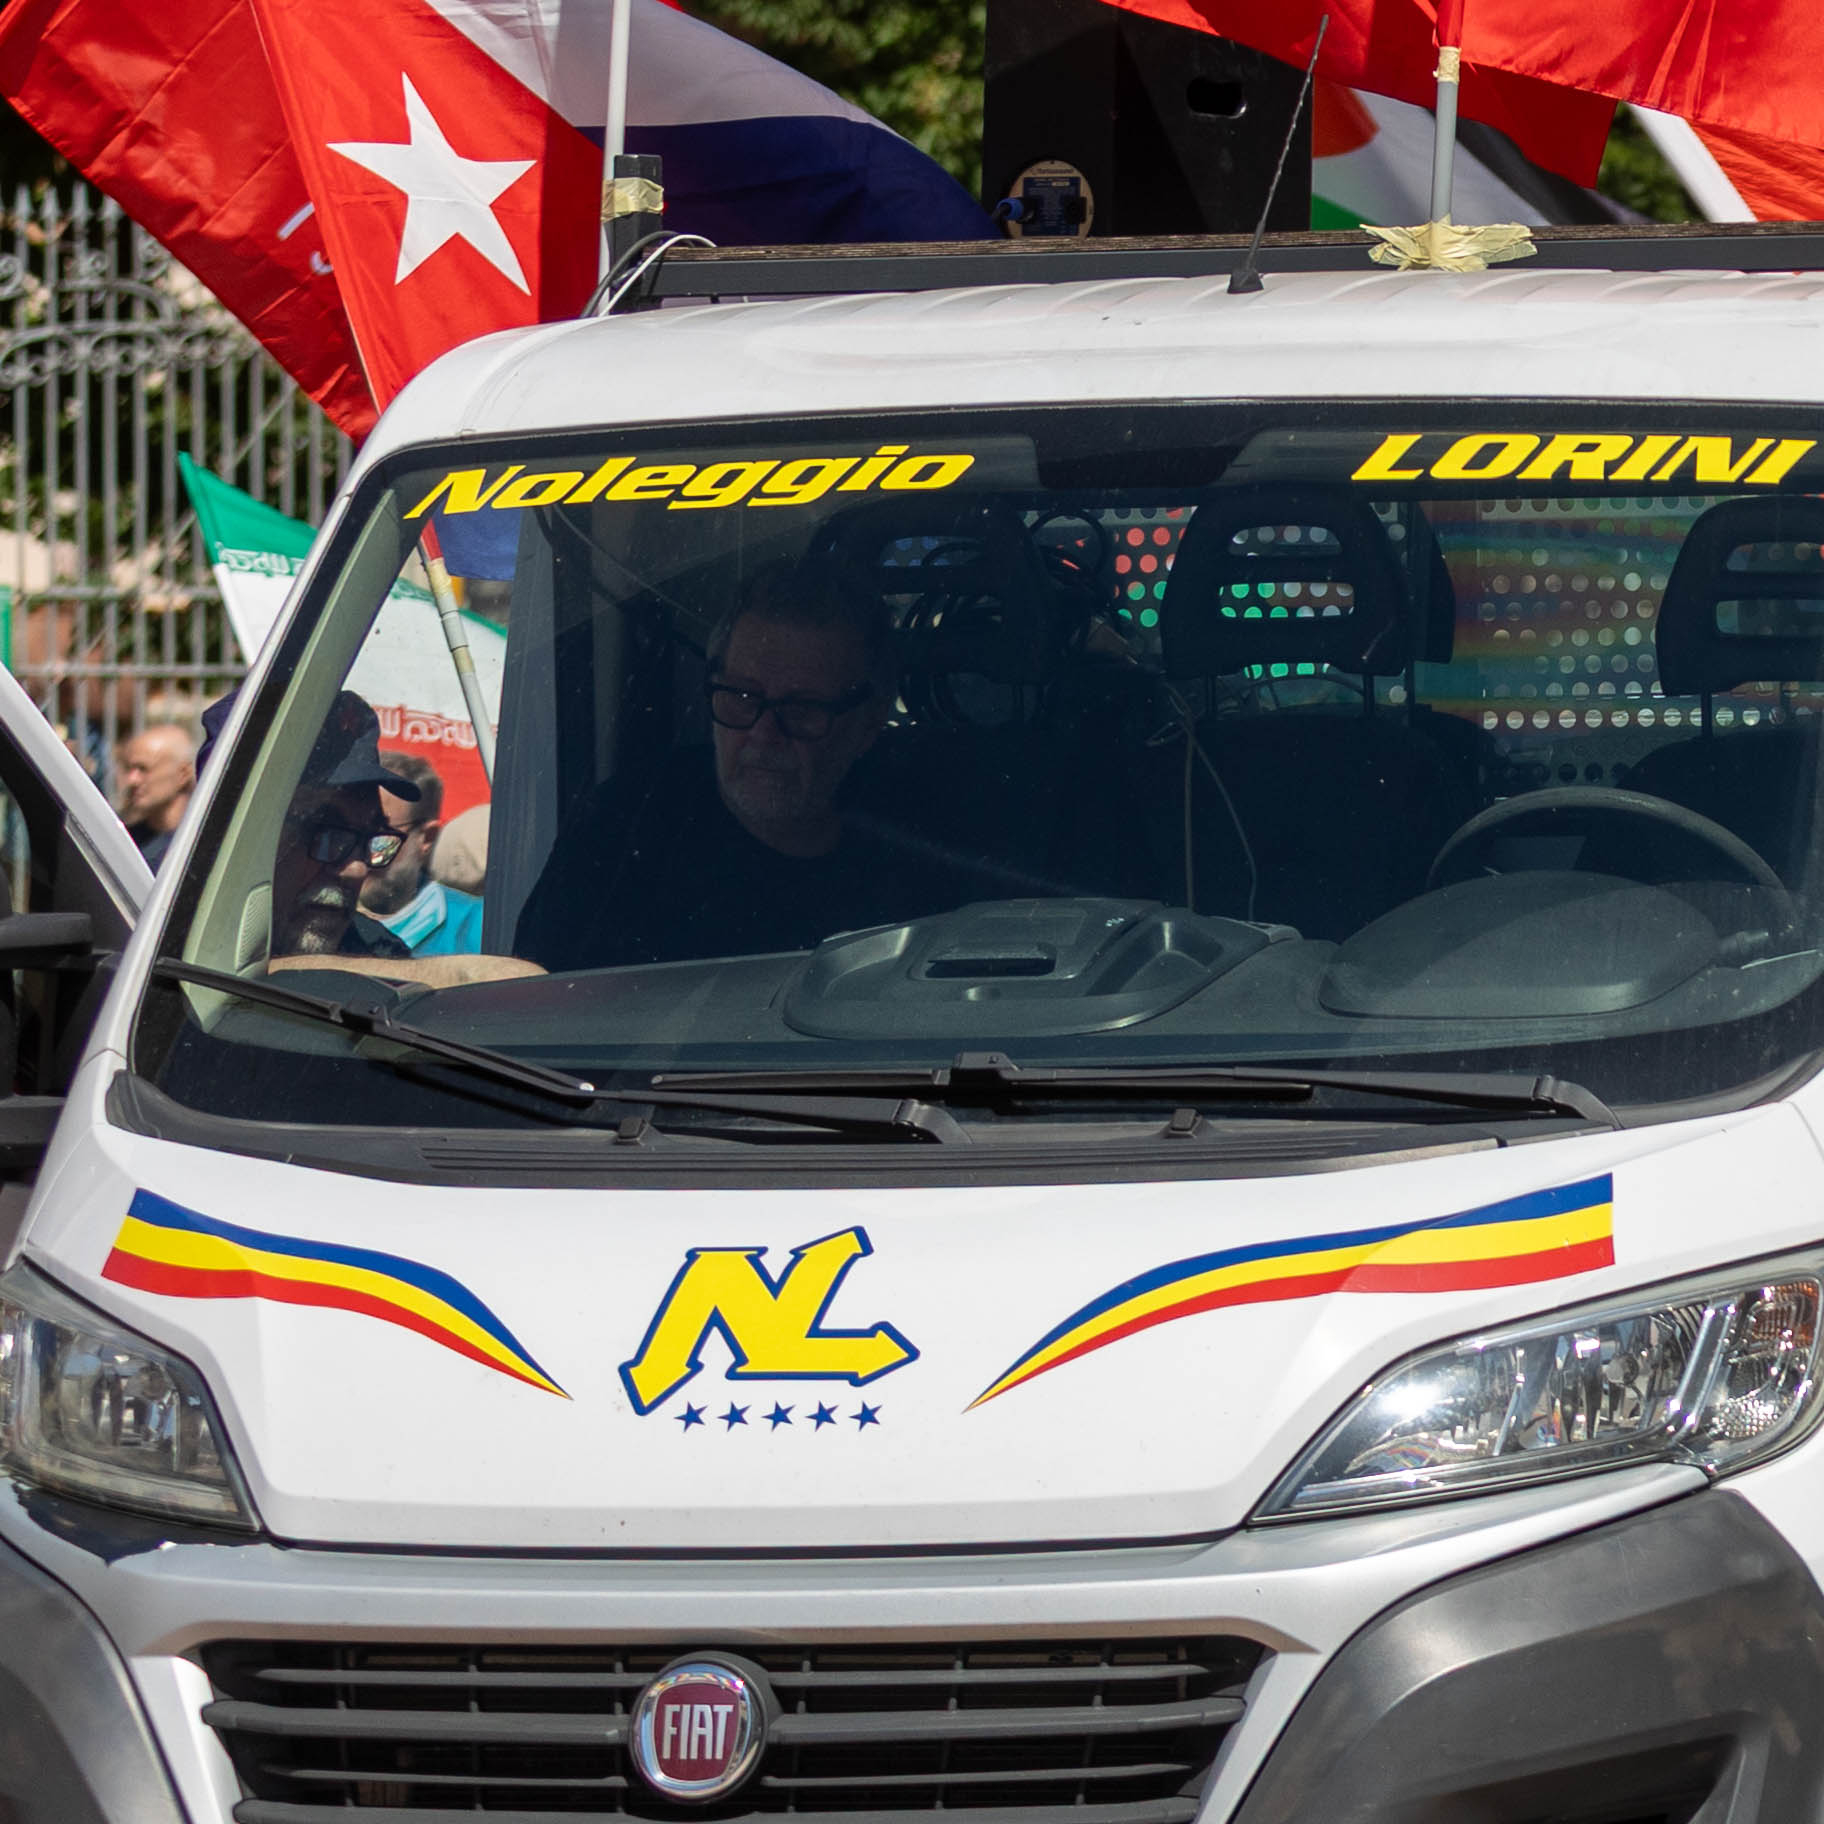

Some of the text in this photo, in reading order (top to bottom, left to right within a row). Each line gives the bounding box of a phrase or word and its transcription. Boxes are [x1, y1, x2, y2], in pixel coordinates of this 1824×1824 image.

[403, 432, 1817, 519] Noleggio LORINI
[662, 1704, 734, 1760] FIAT
